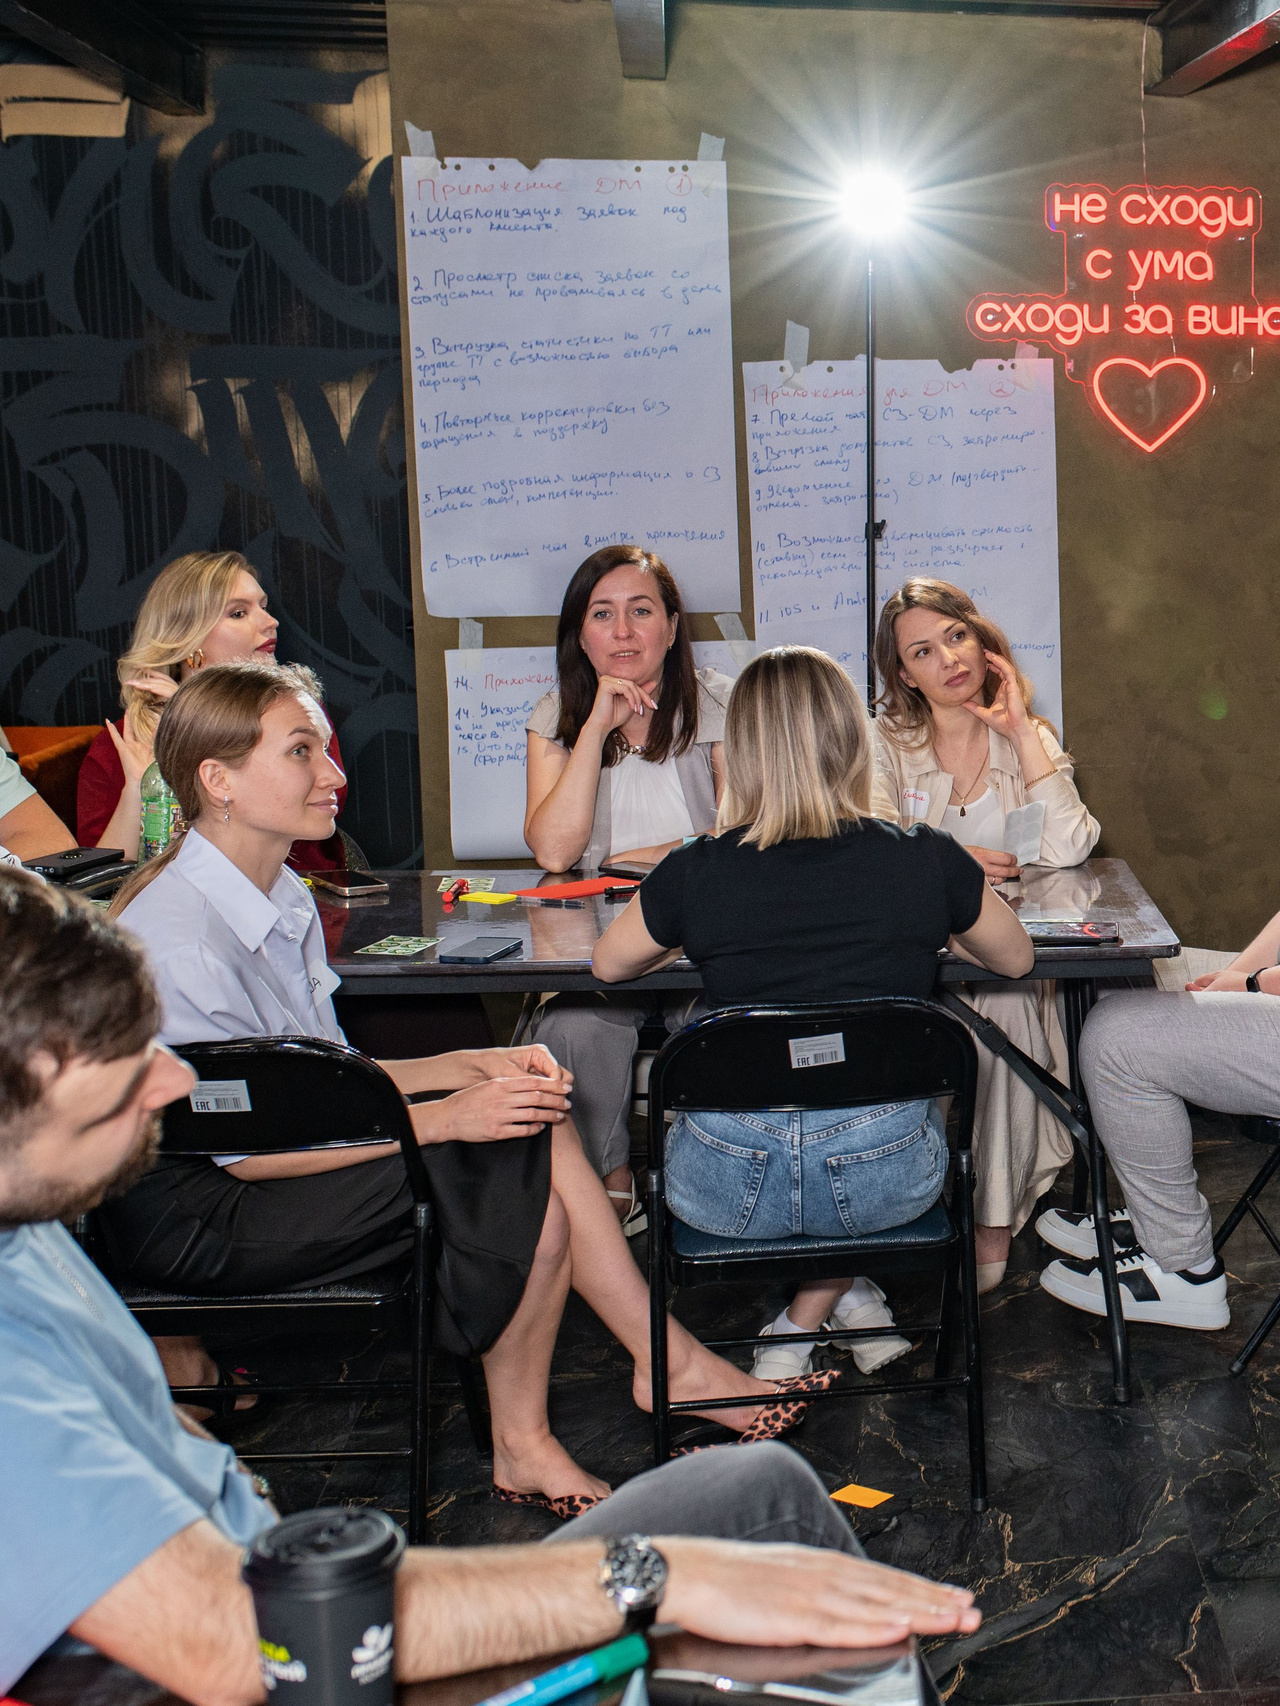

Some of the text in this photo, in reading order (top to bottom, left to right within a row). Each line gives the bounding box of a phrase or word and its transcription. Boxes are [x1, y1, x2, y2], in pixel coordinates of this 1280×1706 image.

[1055, 193, 1252, 238] не сходи
[1086, 250, 1214, 291] с ума
[975, 303, 1109, 345] сходи
[1124, 305, 1174, 334] за
